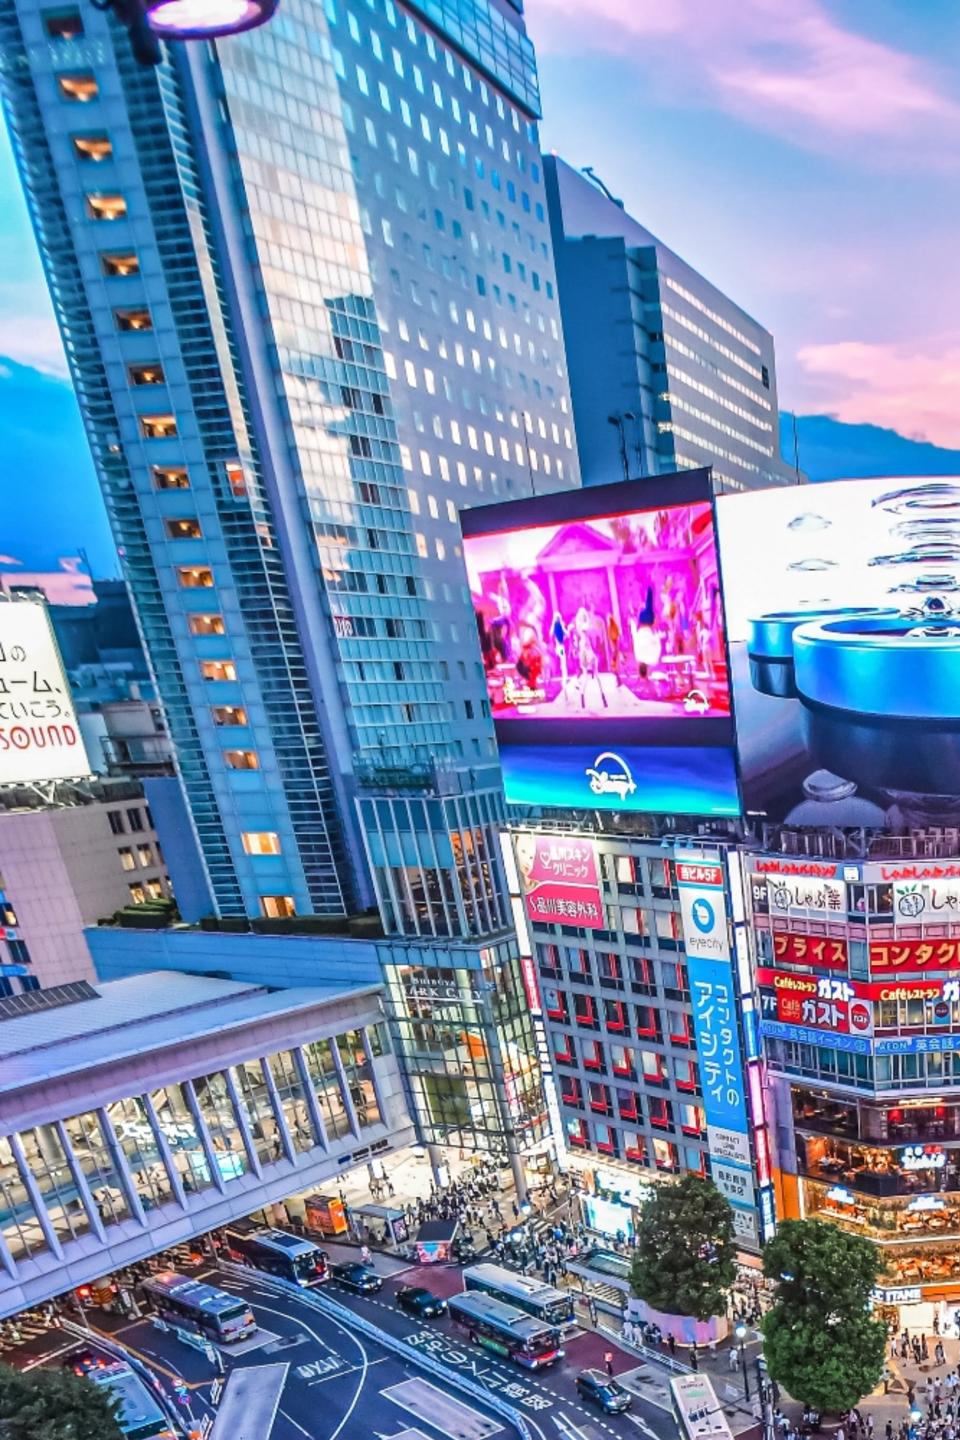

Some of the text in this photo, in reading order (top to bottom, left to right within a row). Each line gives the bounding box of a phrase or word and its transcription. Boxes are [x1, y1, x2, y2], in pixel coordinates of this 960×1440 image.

[552, 863, 589, 878] クリニック
[752, 886, 767, 900] 9F
[537, 897, 599, 920] 品川美容外科
[774, 935, 846, 963] プライス
[818, 979, 855, 1002] ガスト
[761, 995, 778, 1011] 7F
[802, 999, 845, 1027] ガスト
[694, 981, 723, 1103] アイシティ
[715, 984, 740, 1106] コンタクトの
